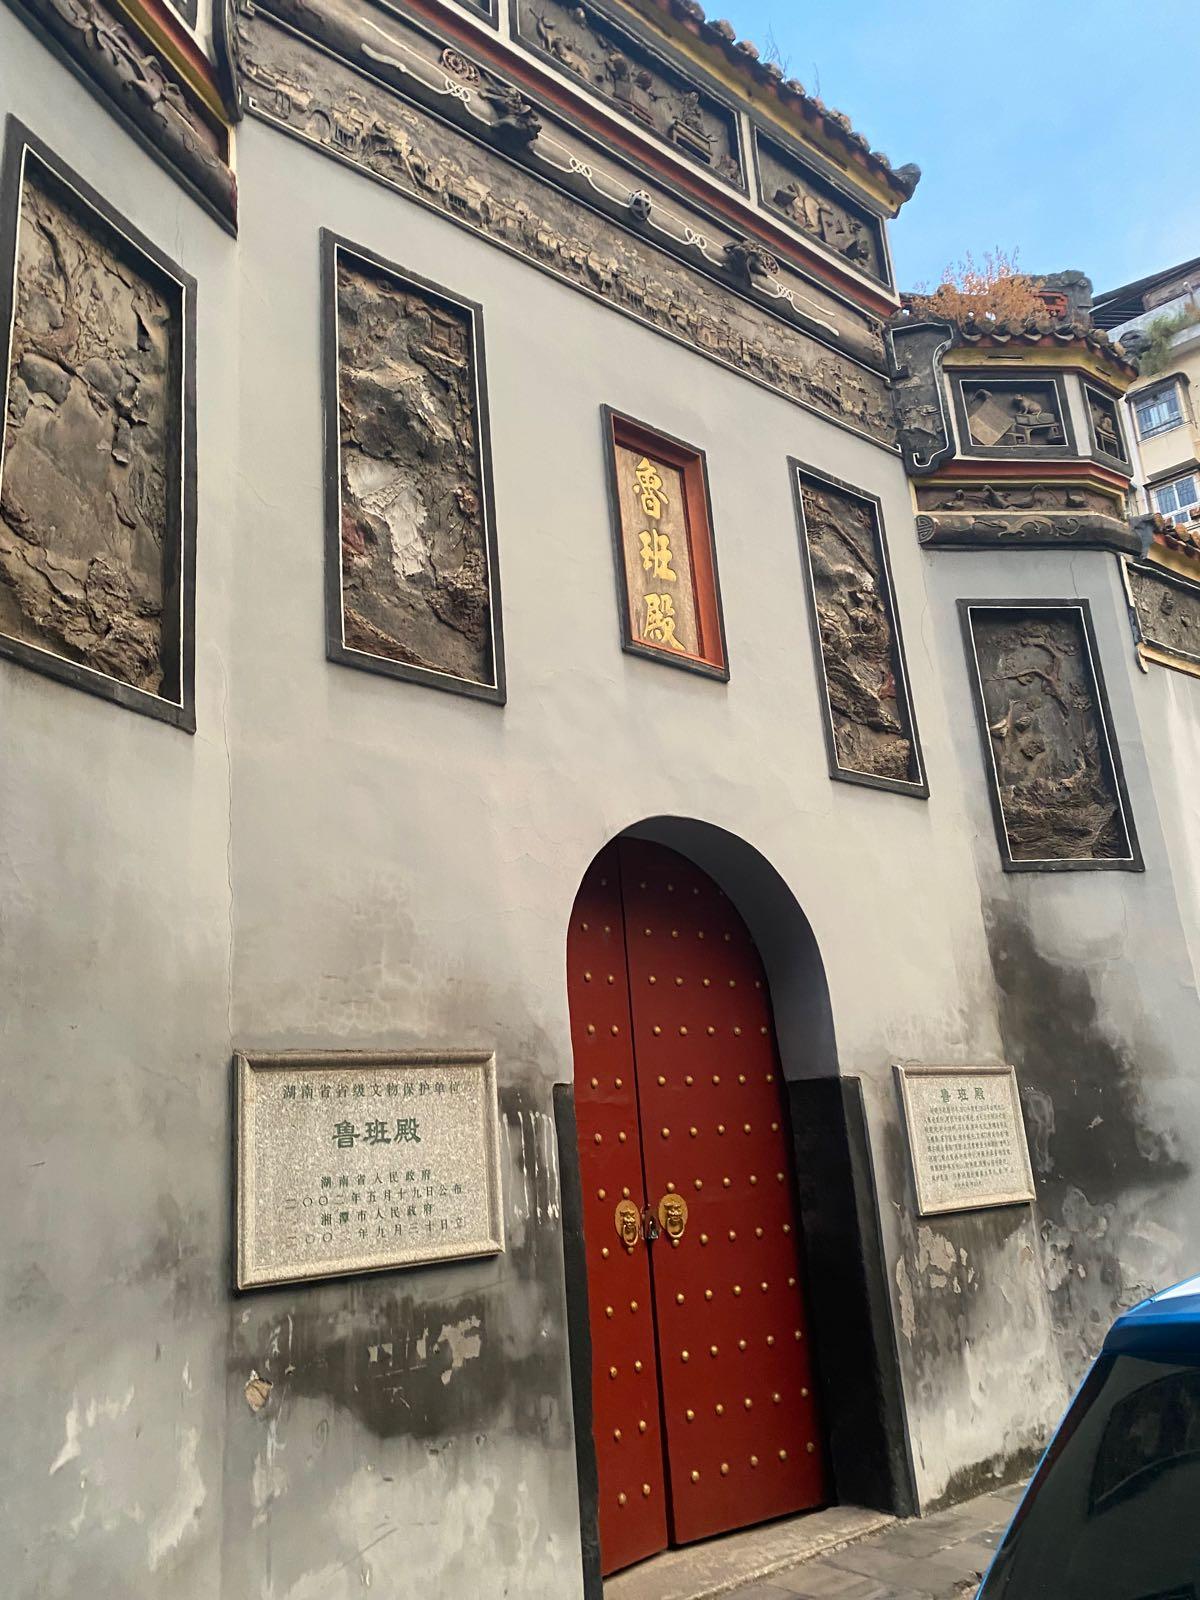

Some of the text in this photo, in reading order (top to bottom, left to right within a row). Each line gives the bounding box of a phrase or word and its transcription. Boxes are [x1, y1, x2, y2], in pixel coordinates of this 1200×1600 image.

[283, 1081, 460, 1099] 湖南省省级文物保护单位
[332, 1118, 421, 1148] 鲁班殿
[321, 1169, 431, 1189] 湖南省人民政府
[321, 1203, 433, 1226] 湘潭市人民政府
